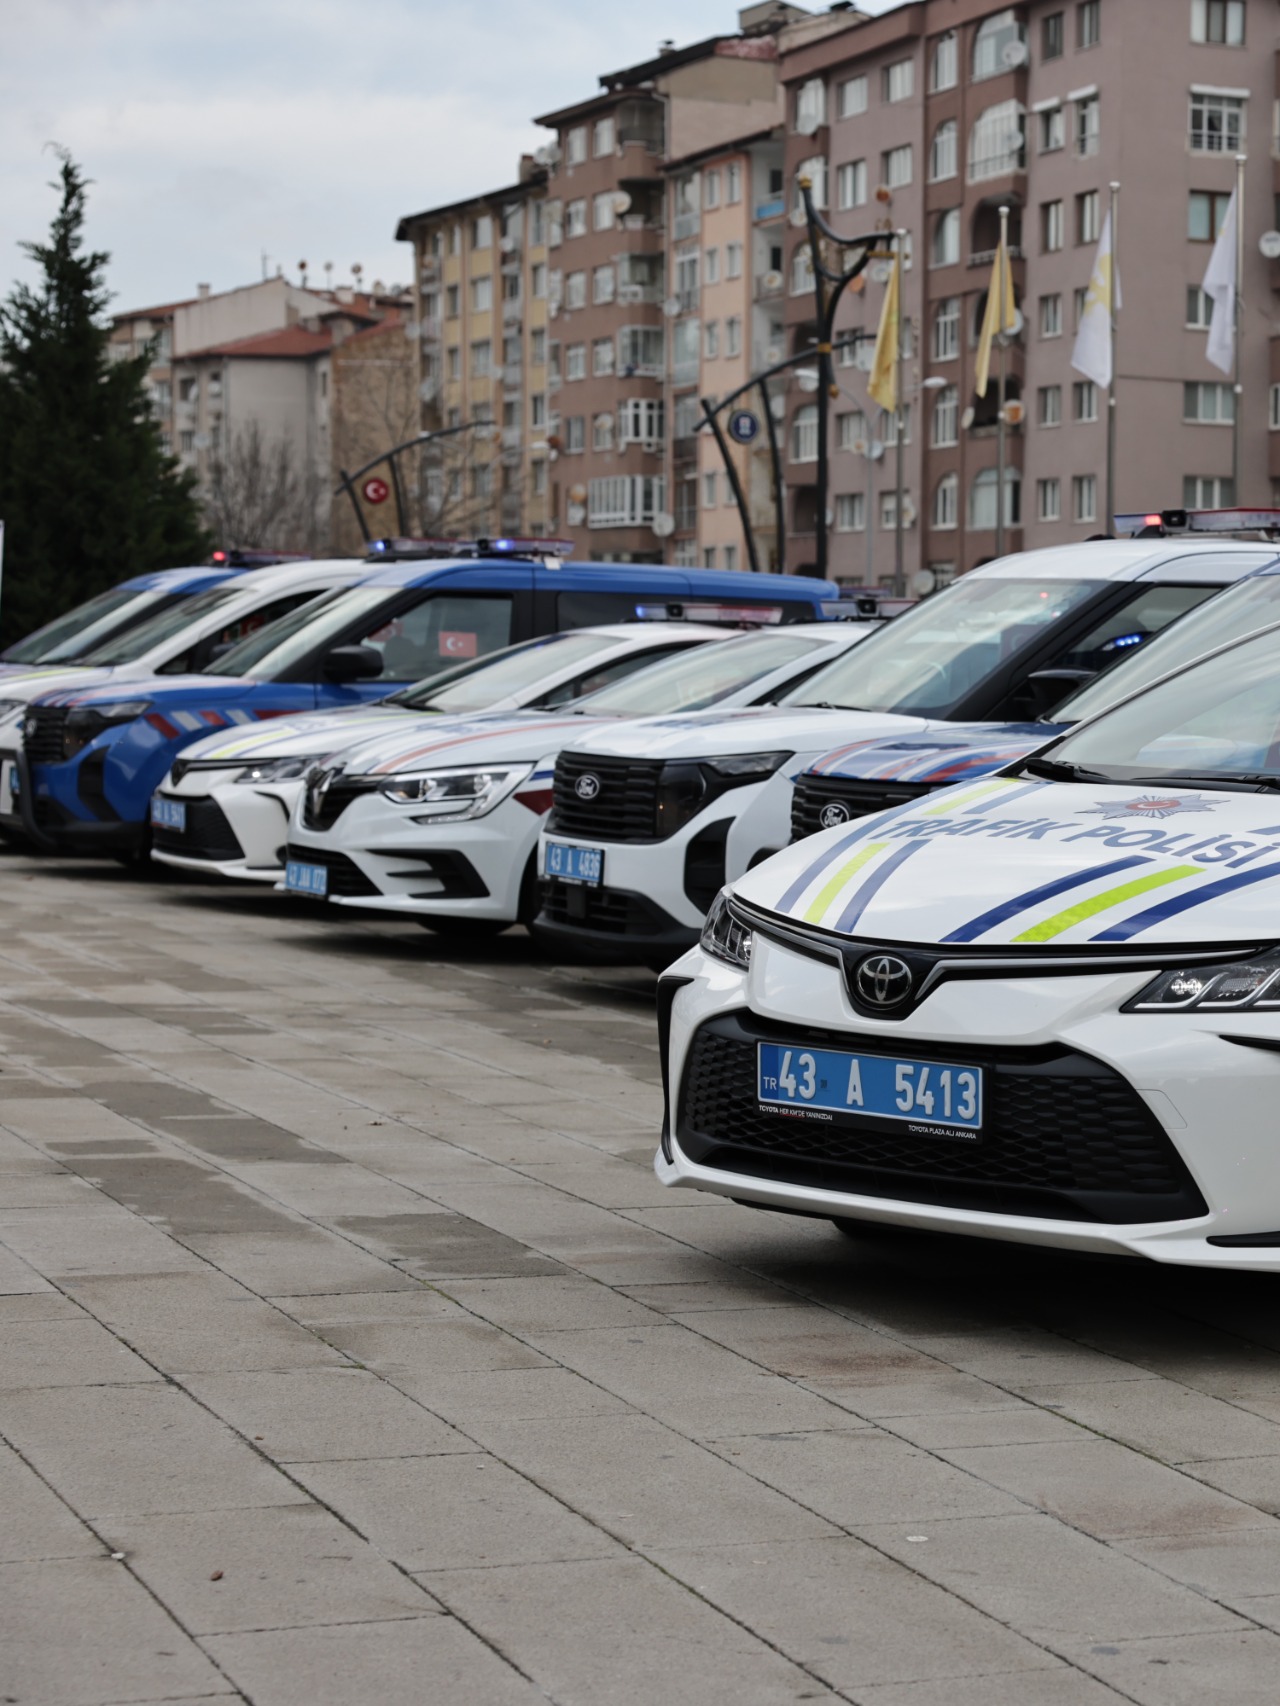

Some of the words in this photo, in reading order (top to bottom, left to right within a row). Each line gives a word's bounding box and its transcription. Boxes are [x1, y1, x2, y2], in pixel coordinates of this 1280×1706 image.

[867, 817, 1084, 840] TRAFİK
[763, 1076, 778, 1090] TR
[779, 1050, 817, 1100] 43
[846, 1058, 864, 1107] A
[895, 1063, 977, 1120] 5413
[758, 1104, 779, 1113] TOYOTA
[908, 1124, 929, 1133] TOYOTA
[929, 1127, 945, 1135] PLAZA
[955, 1131, 977, 1140] ANKARA
